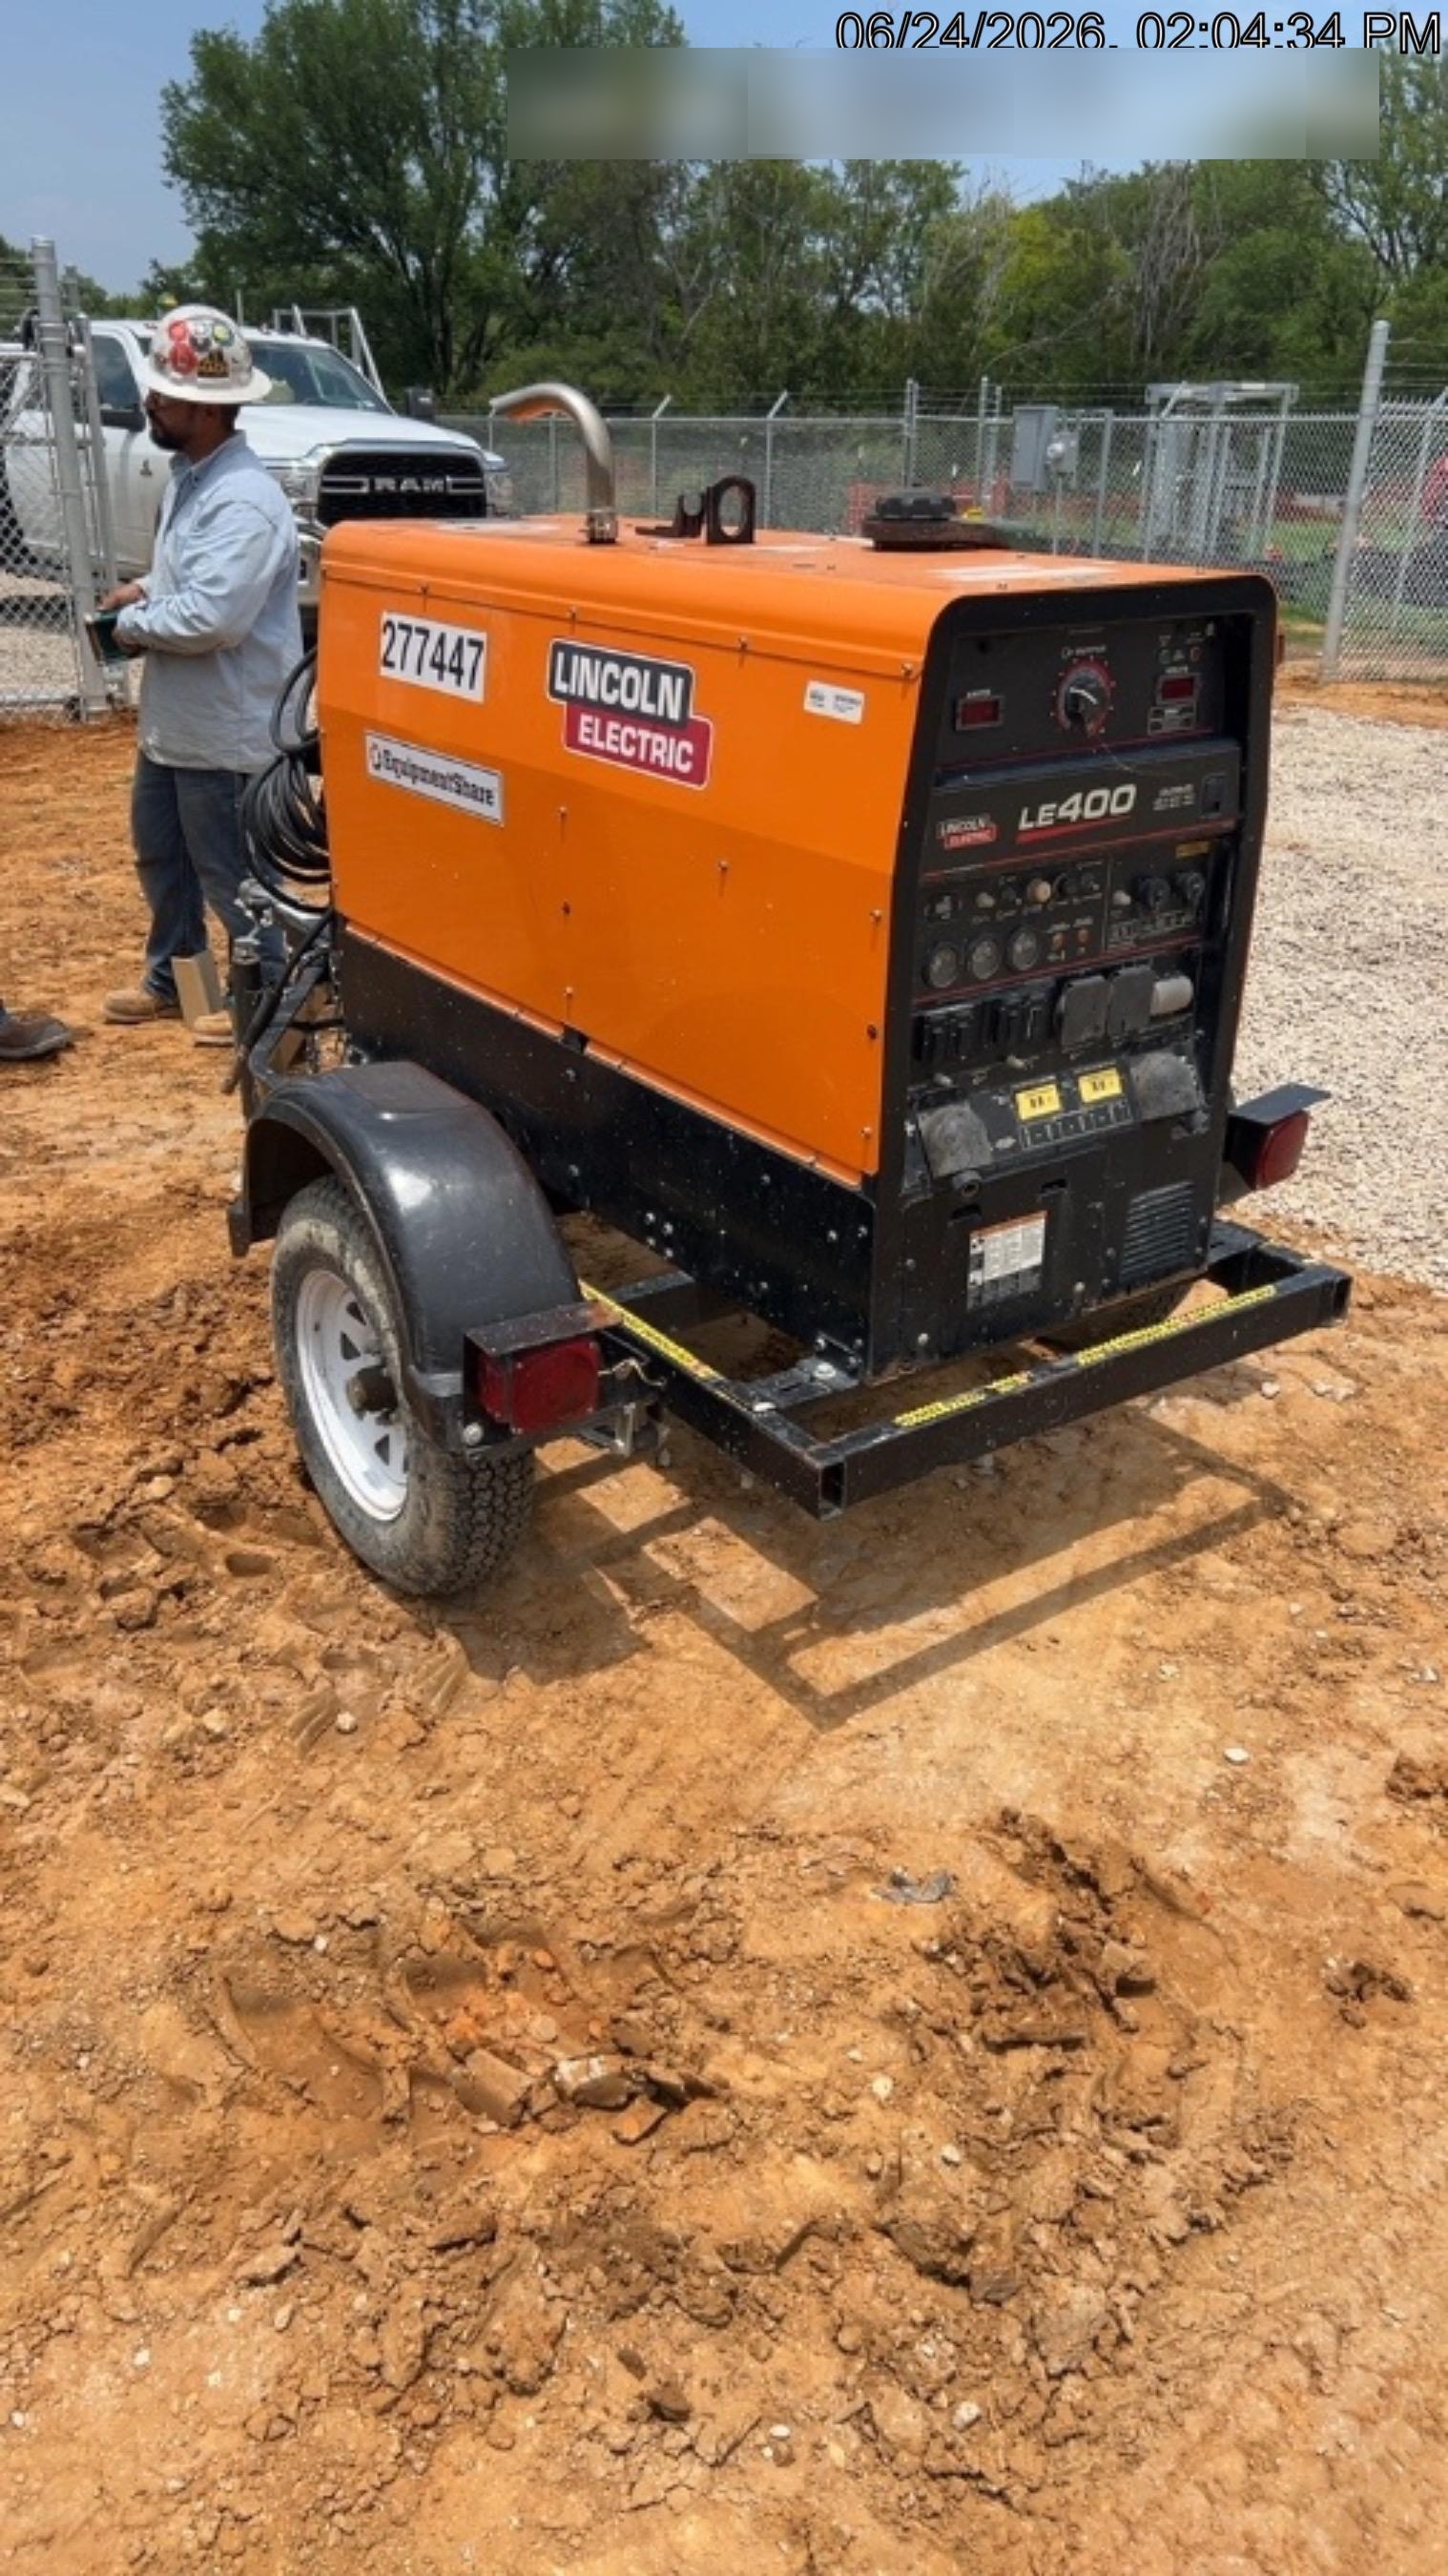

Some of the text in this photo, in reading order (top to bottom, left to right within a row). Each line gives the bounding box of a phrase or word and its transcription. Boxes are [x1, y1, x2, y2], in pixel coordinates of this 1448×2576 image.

[374, 477, 445, 493] RAM
[383, 621, 484, 690] 277447
[554, 653, 684, 720] LINCOLN
[578, 714, 693, 774] ELECTRIC
[1018, 783, 1137, 831] LE400
